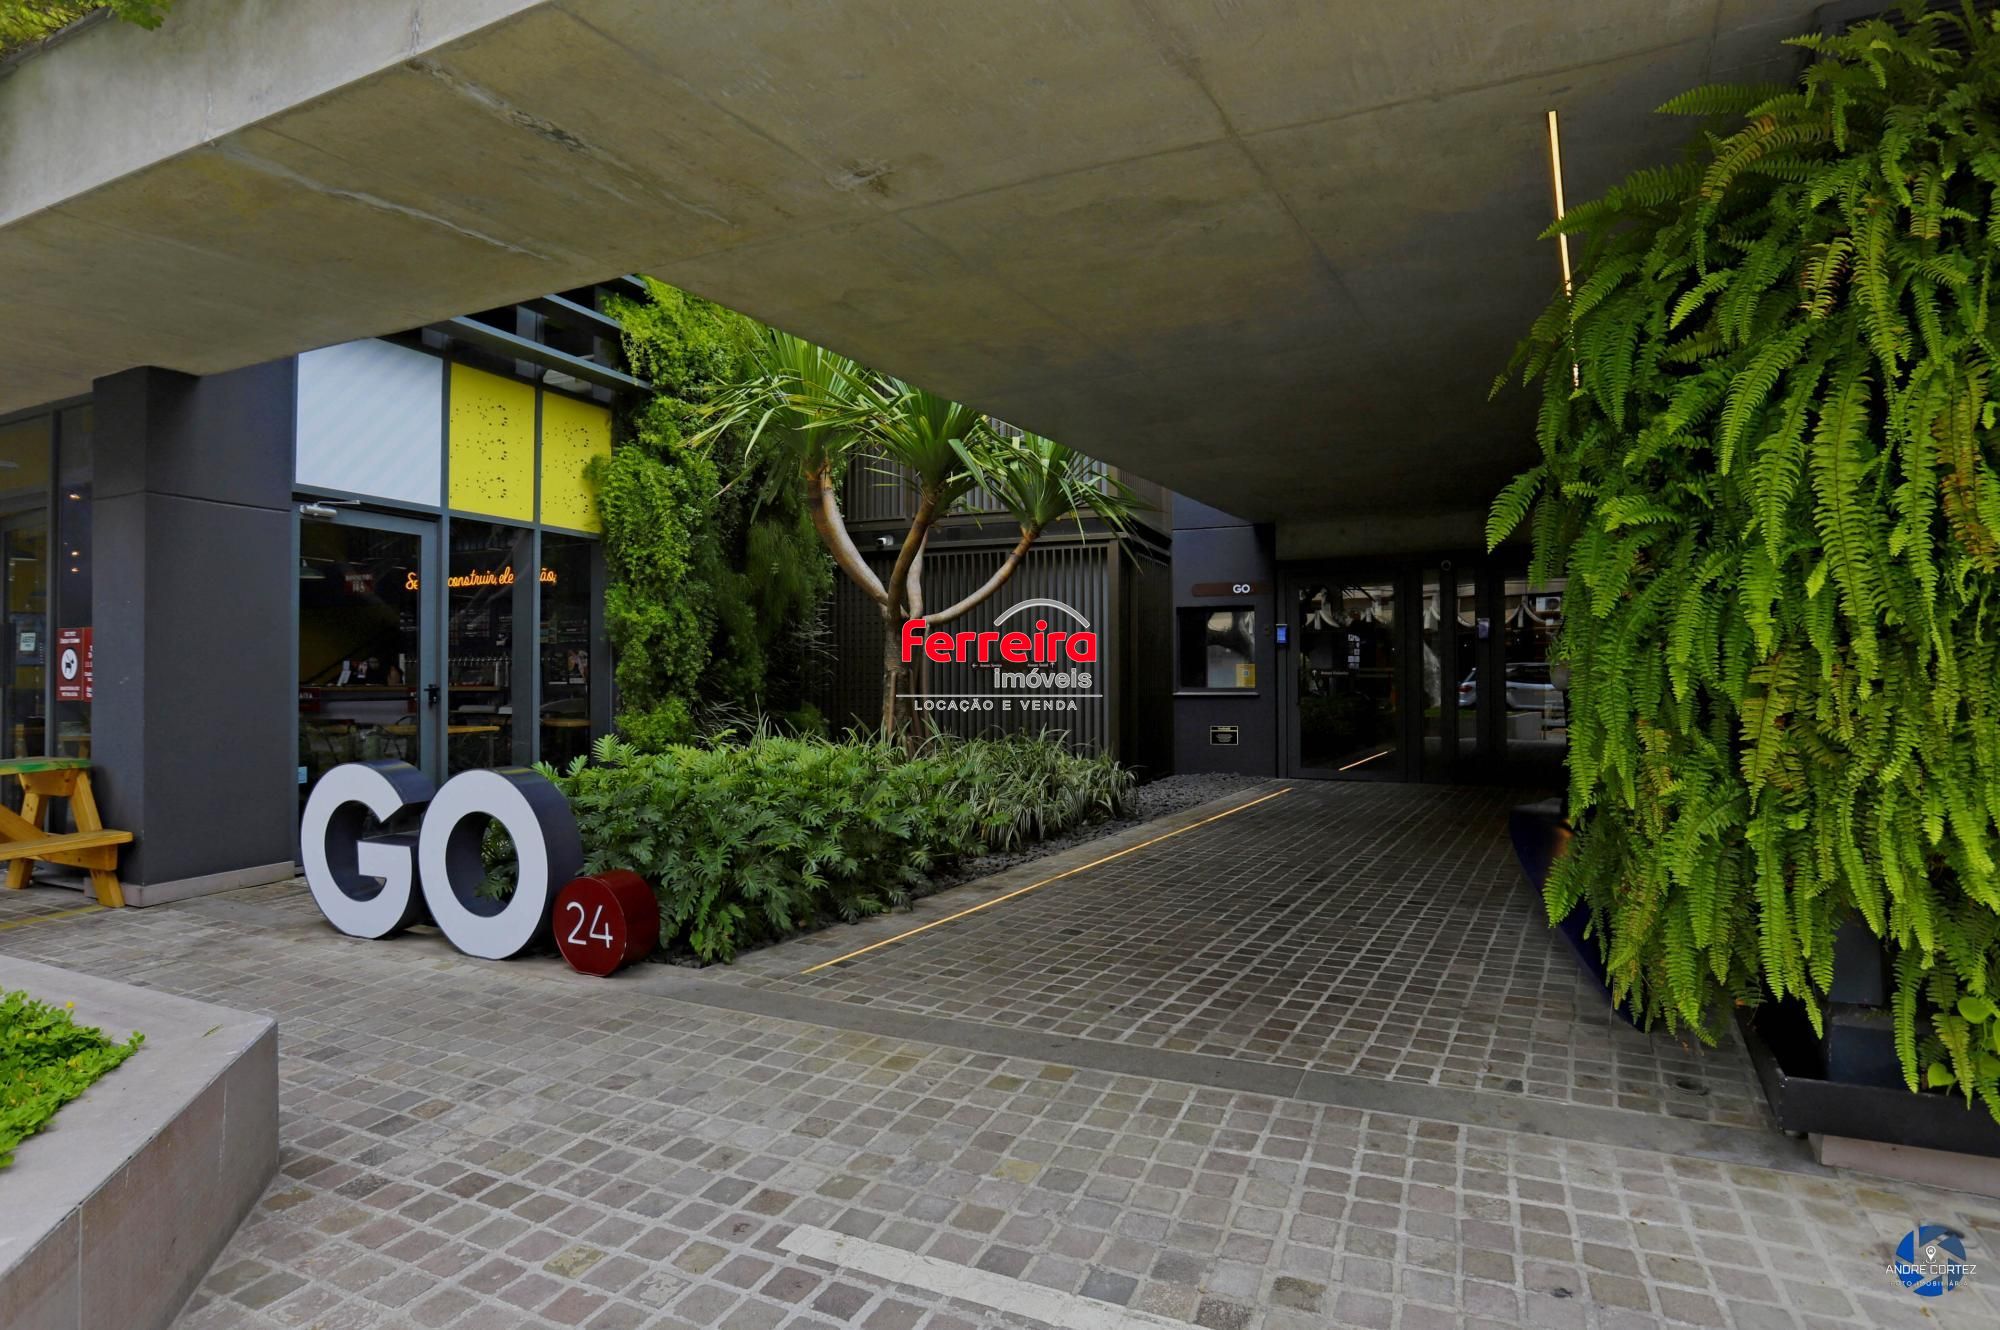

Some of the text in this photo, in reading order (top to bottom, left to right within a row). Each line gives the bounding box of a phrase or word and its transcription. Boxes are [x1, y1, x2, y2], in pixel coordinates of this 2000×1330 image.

[1232, 583, 1251, 594] GO
[301, 762, 548, 961] GO
[566, 901, 613, 948] 24
